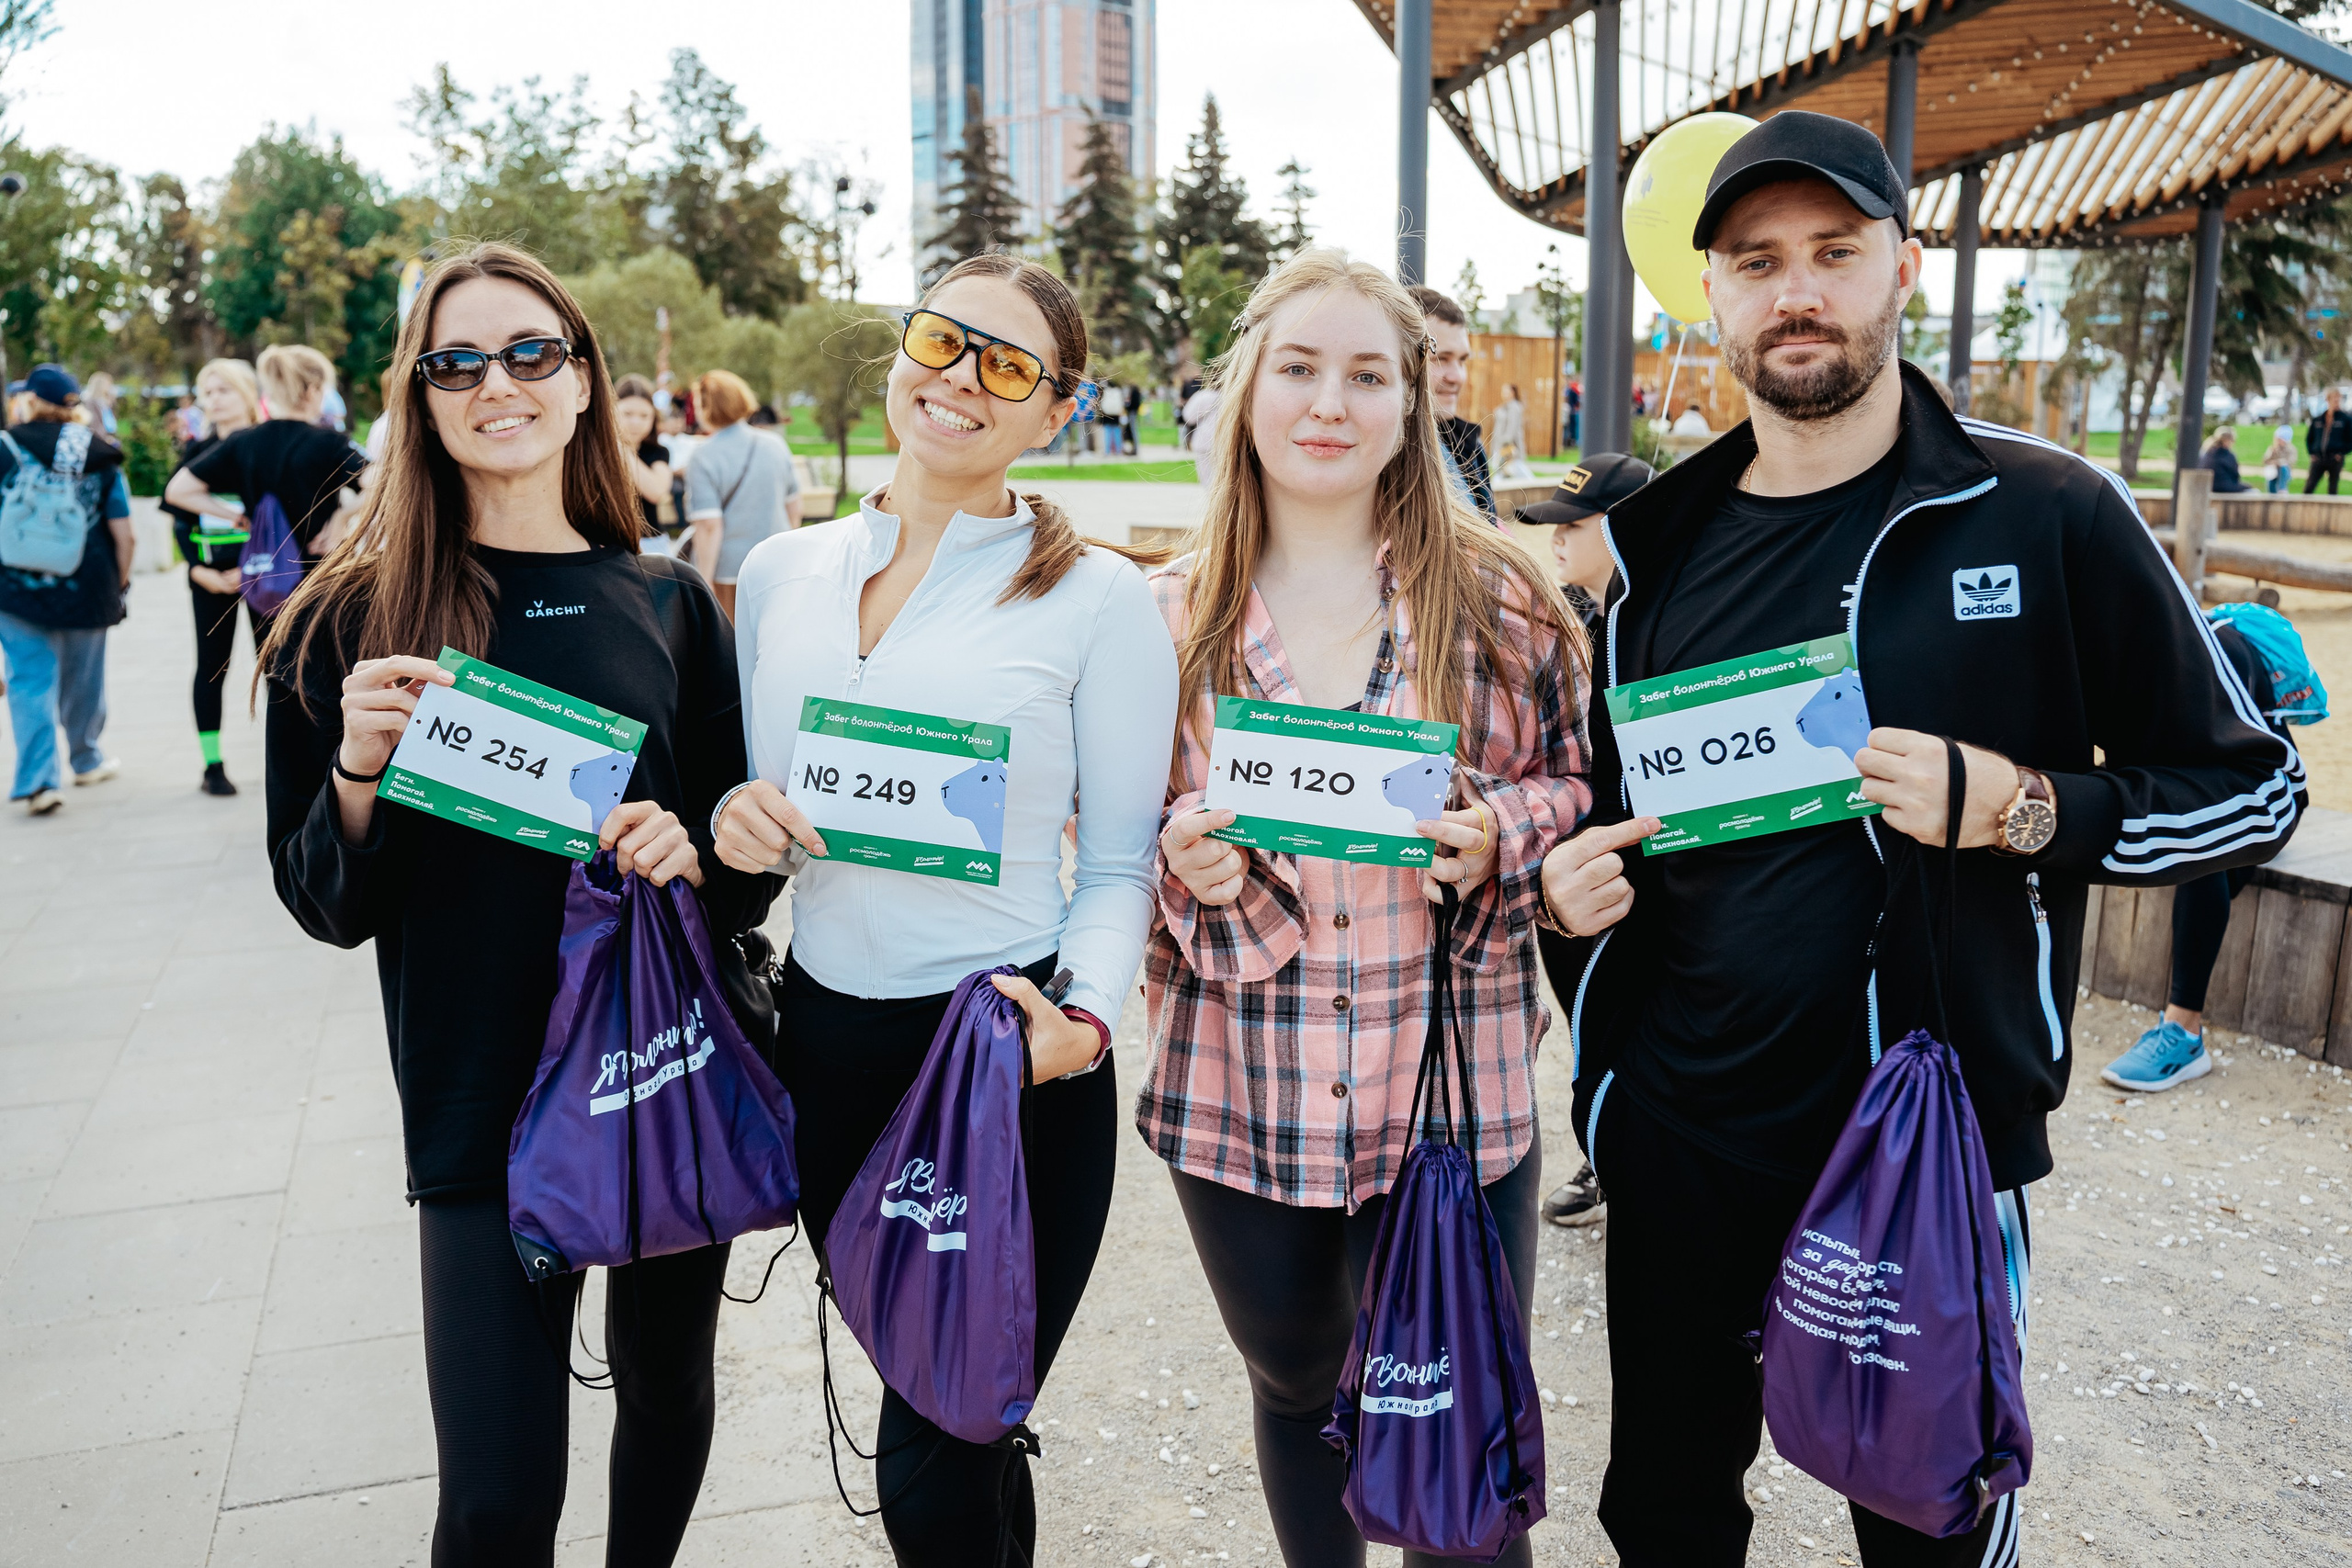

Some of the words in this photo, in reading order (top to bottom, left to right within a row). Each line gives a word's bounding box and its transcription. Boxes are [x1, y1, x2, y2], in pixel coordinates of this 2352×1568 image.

[1961, 603, 2013, 616] adidas
[1639, 690, 1671, 704] Забег
[1672, 671, 1747, 696] волонтёров
[1748, 660, 1796, 679] Южного
[1798, 651, 1835, 667] Урала
[466, 671, 497, 689] Забег
[498, 683, 561, 714] волонтёров
[563, 707, 602, 728] Южного
[605, 722, 630, 739] Урала
[824, 712, 849, 724] Забег
[851, 716, 912, 735] волонтёров
[916, 727, 958, 741] Южного
[961, 733, 993, 746] Урала
[1250, 711, 1281, 722] Забег
[1283, 715, 1355, 731] волонтёров
[1358, 724, 1404, 738] Южного
[1407, 730, 1440, 743] Урала
[426, 716, 472, 752] №
[481, 739, 549, 780] 254
[1639, 746, 1686, 780] №
[1701, 726, 1776, 765] 026
[390, 781, 425, 797] Помогай.
[394, 773, 414, 784] Беги.
[803, 763, 840, 795] №
[853, 773, 916, 806] 249
[1229, 758, 1273, 785] №
[1290, 767, 1355, 795] 120
[387, 789, 435, 810] Вдохновляй.
[1211, 830, 1259, 844] Вдохновляй.
[1649, 829, 1687, 841] Помогай.
[1651, 835, 1702, 851] Вдохновляй.
[662, 1059, 697, 1077] Ураа
[1802, 1248, 1823, 1263] за
[1785, 1255, 1839, 1290] оторые
[1782, 1309, 1838, 1340] ожидая
